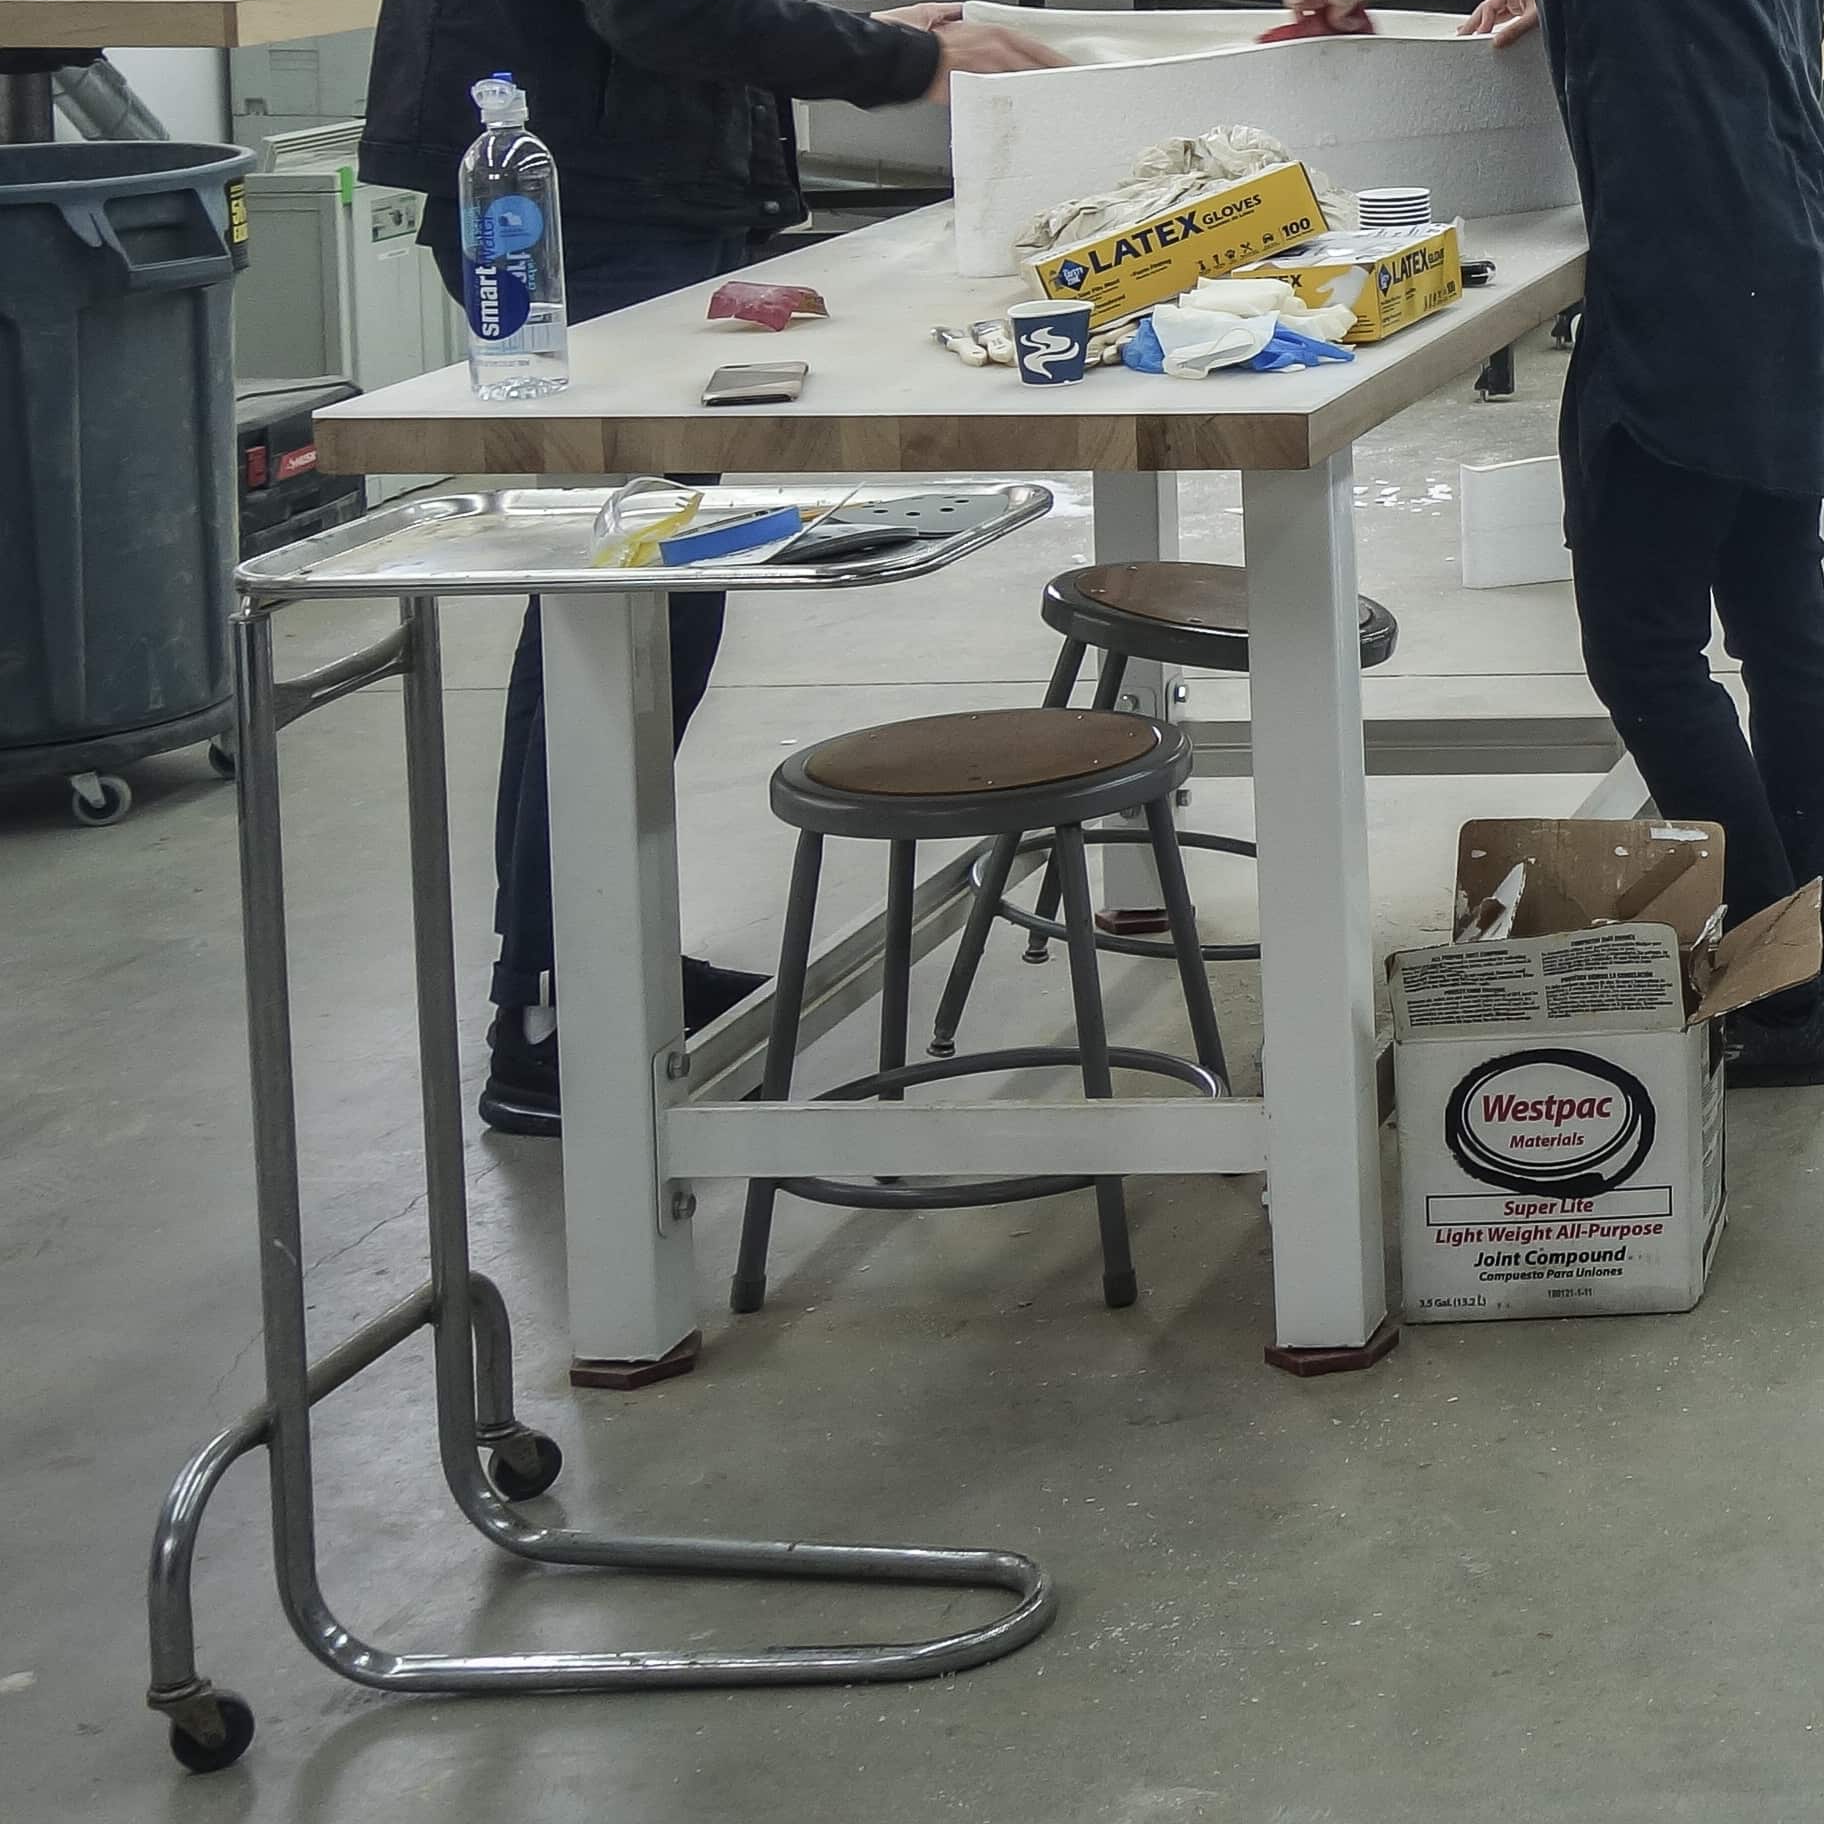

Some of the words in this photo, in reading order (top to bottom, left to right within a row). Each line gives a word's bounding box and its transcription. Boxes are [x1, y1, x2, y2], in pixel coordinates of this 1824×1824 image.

[1088, 211, 1204, 274] LATEX
[1202, 194, 1262, 226] GLOVES
[1282, 217, 1311, 237] 100
[1392, 247, 1429, 284] LATEX
[1482, 1094, 1613, 1127] Westpac
[1509, 1132, 1585, 1149] Materials
[1504, 1201, 1557, 1218] Super
[1560, 1199, 1594, 1214] Lite
[1435, 1227, 1483, 1247] Light
[1488, 1226, 1552, 1244] Weight
[1556, 1222, 1664, 1240] All-Purpose
[1474, 1251, 1521, 1267] Joint
[1525, 1246, 1627, 1266] Compound
[1479, 1270, 1544, 1283] Compuesto
[1546, 1269, 1574, 1280] Para
[1575, 1266, 1623, 1278] Uniones
